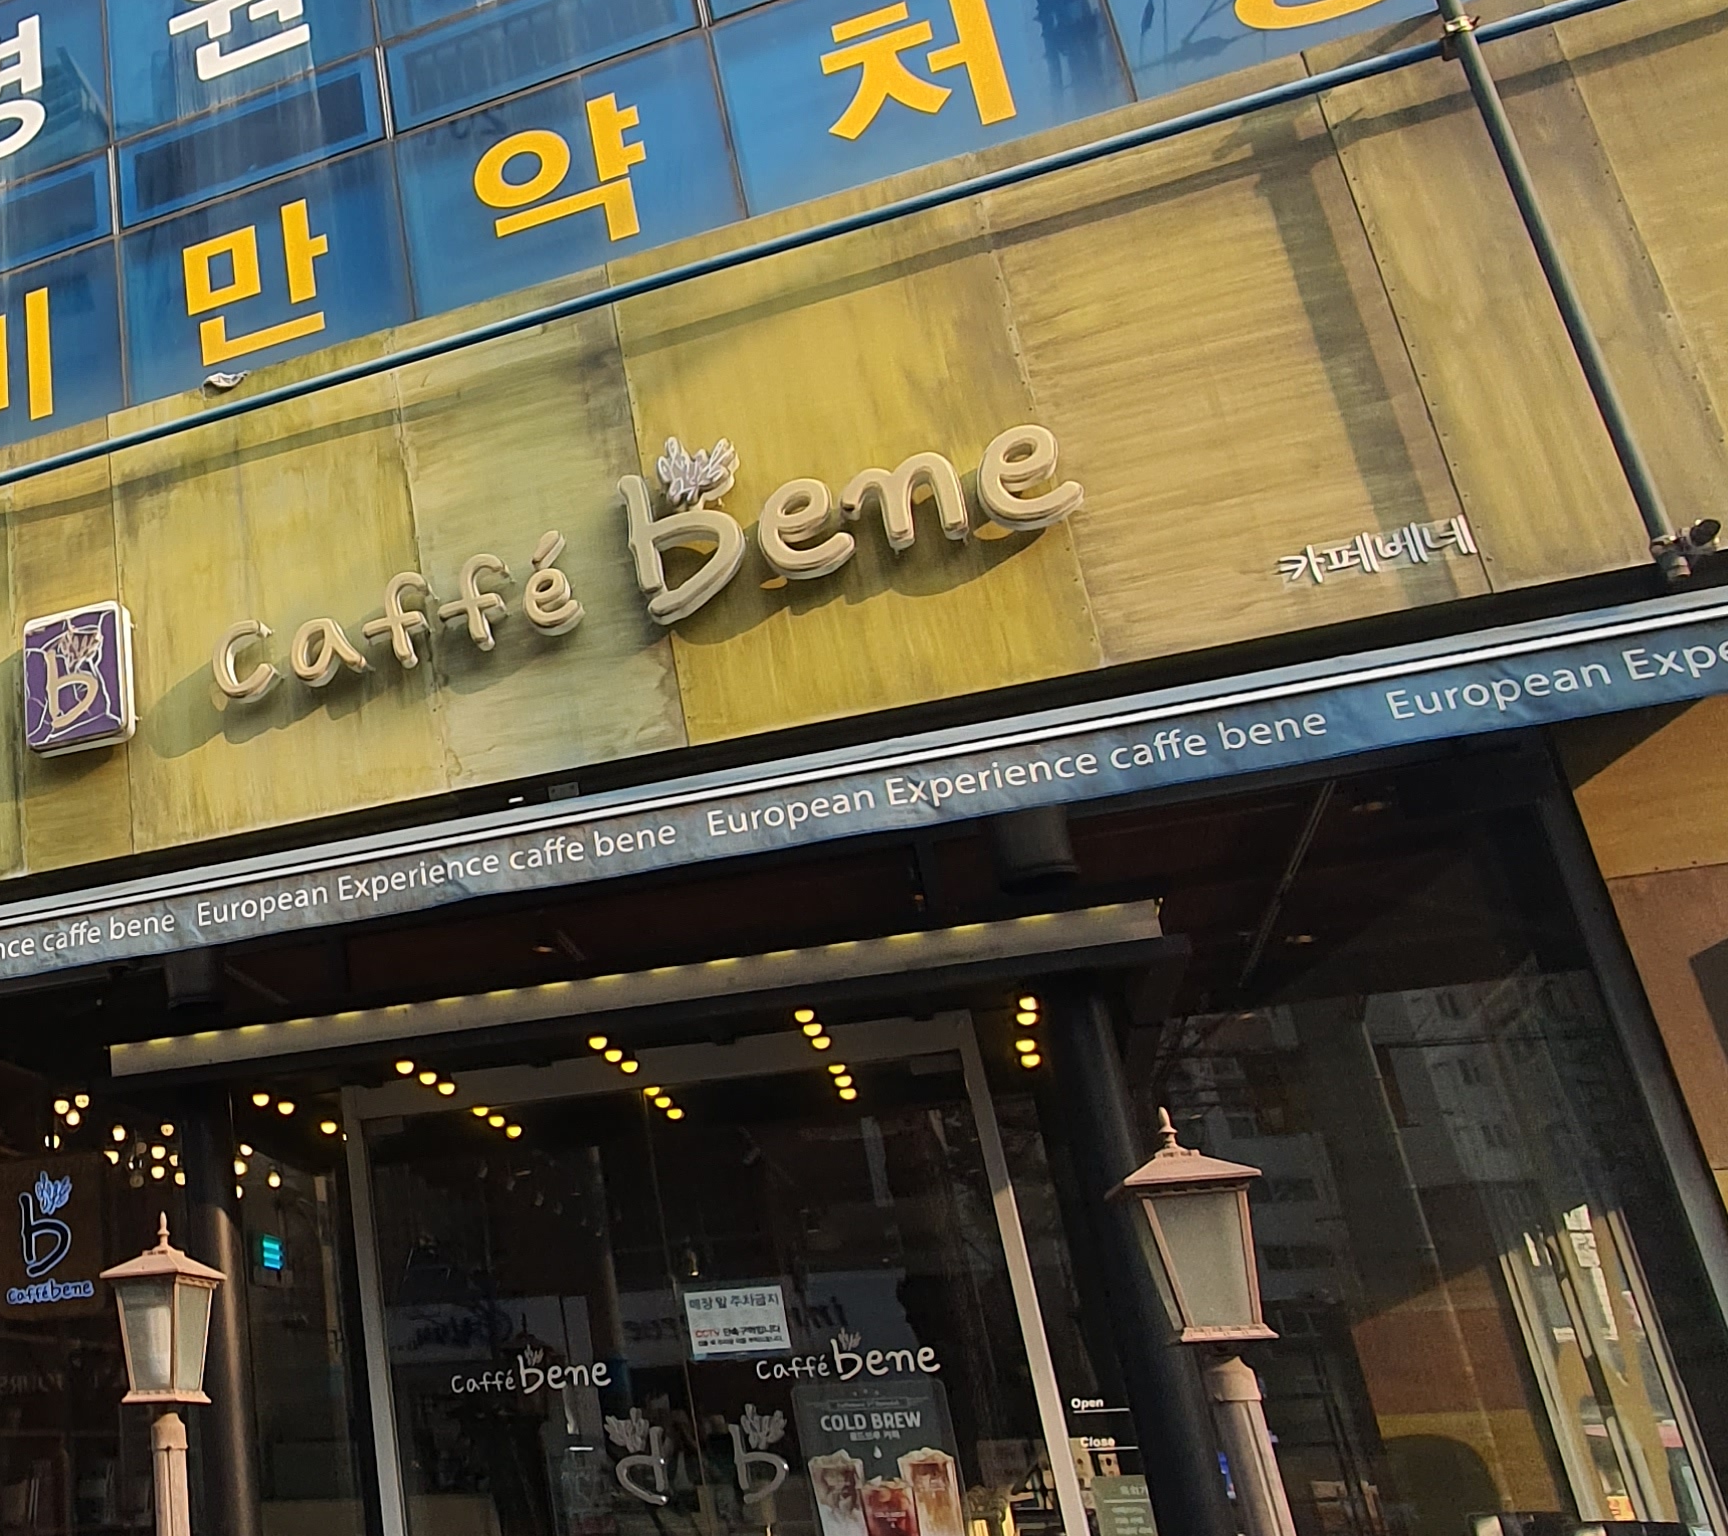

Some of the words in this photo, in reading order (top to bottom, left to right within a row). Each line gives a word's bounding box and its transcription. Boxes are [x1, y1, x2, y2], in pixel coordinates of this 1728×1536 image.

[618, 424, 1085, 627] bene
[1278, 514, 1477, 586] 카페베네
[42, 921, 102, 952] caffe
[109, 913, 175, 941] bene
[197, 886, 329, 927] European
[337, 855, 500, 902] Experience
[510, 833, 585, 870] caffe
[593, 825, 677, 858] bene
[706, 790, 875, 837] European
[884, 753, 1100, 807] Experience
[1109, 728, 1208, 769] caffe
[1217, 713, 1328, 751] bene
[1385, 663, 1612, 721] European
[730, 1292, 780, 1308] 주차금지
[695, 1327, 720, 1339] CCTV
[517, 1354, 612, 1394] bene
[831, 1337, 942, 1381] bene
[1070, 1398, 1105, 1410] Open
[820, 1413, 867, 1432] COLD
[870, 1410, 922, 1431] BREW
[1079, 1436, 1116, 1448] Close
